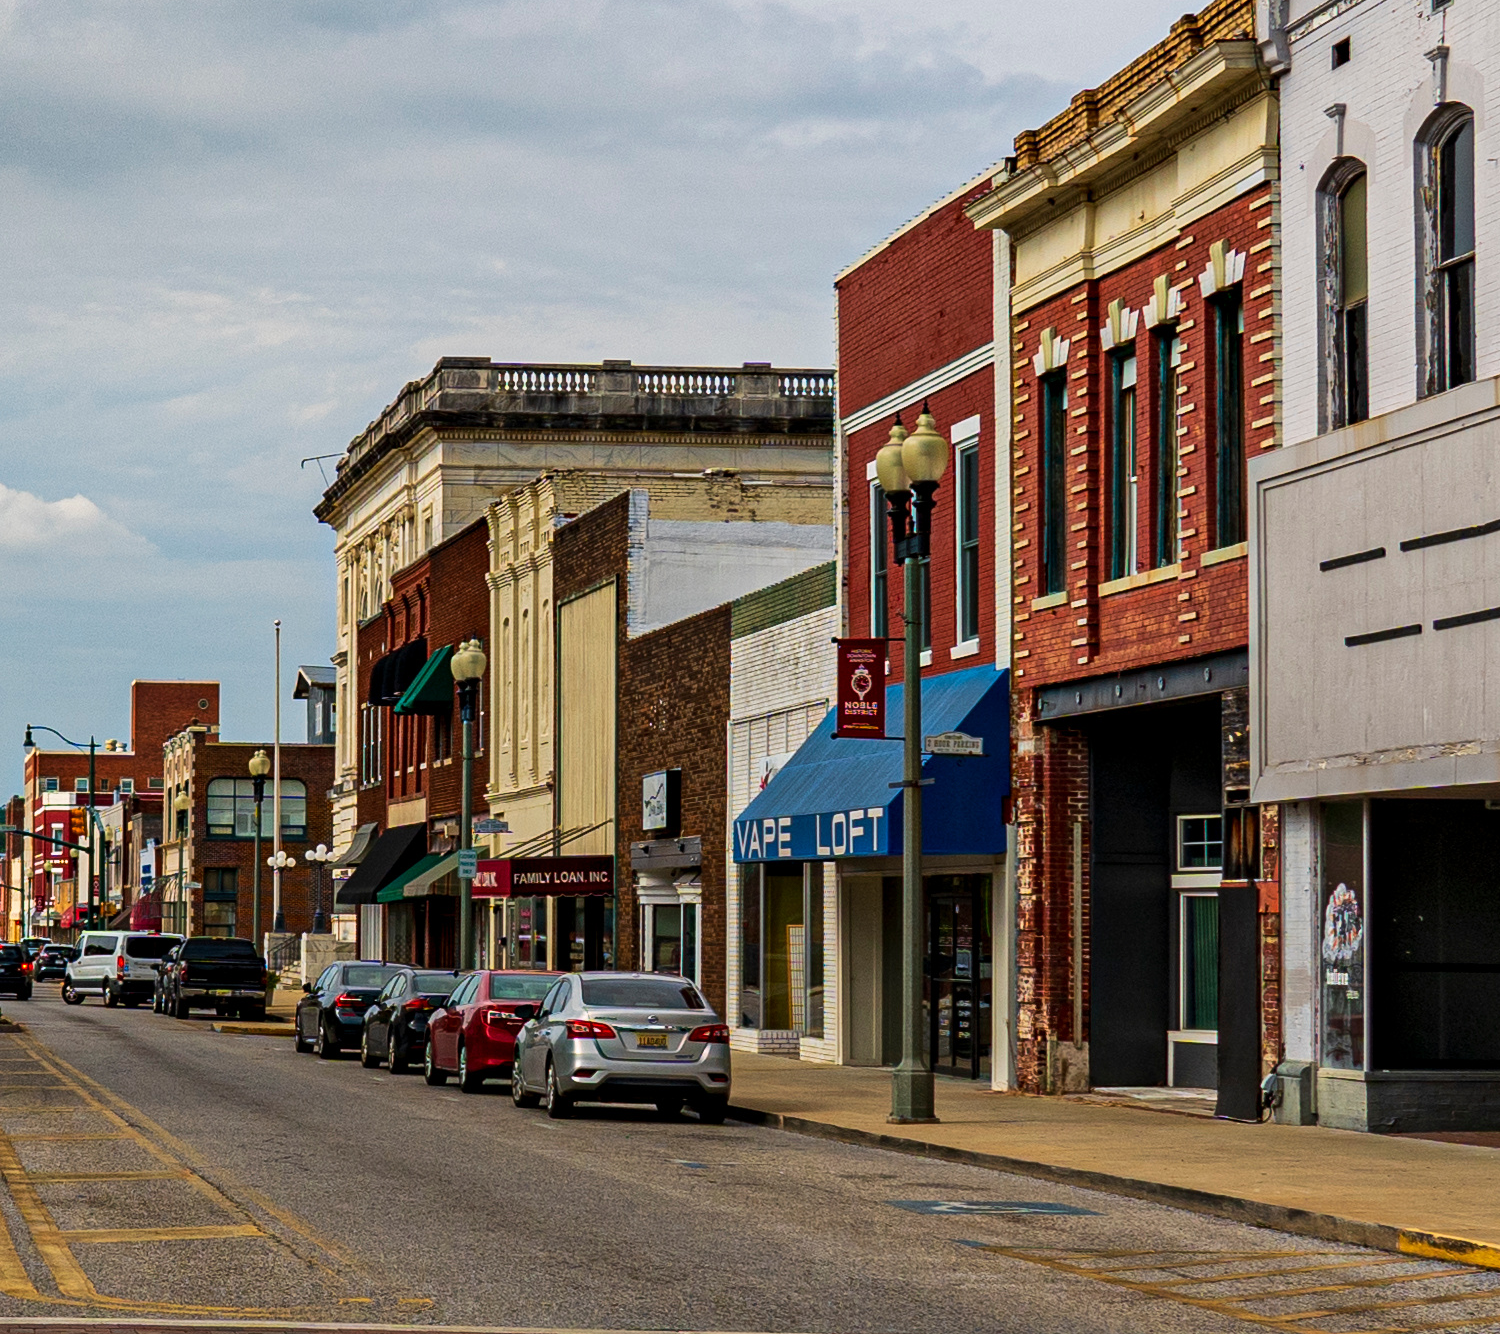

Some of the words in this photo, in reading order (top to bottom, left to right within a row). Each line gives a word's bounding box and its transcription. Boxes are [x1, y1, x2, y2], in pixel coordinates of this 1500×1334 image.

[844, 701, 878, 709] NOBLE
[737, 817, 792, 859] VAPE
[816, 807, 884, 856] LOFT
[513, 872, 552, 884] FAMILY
[589, 871, 611, 883] INC.
